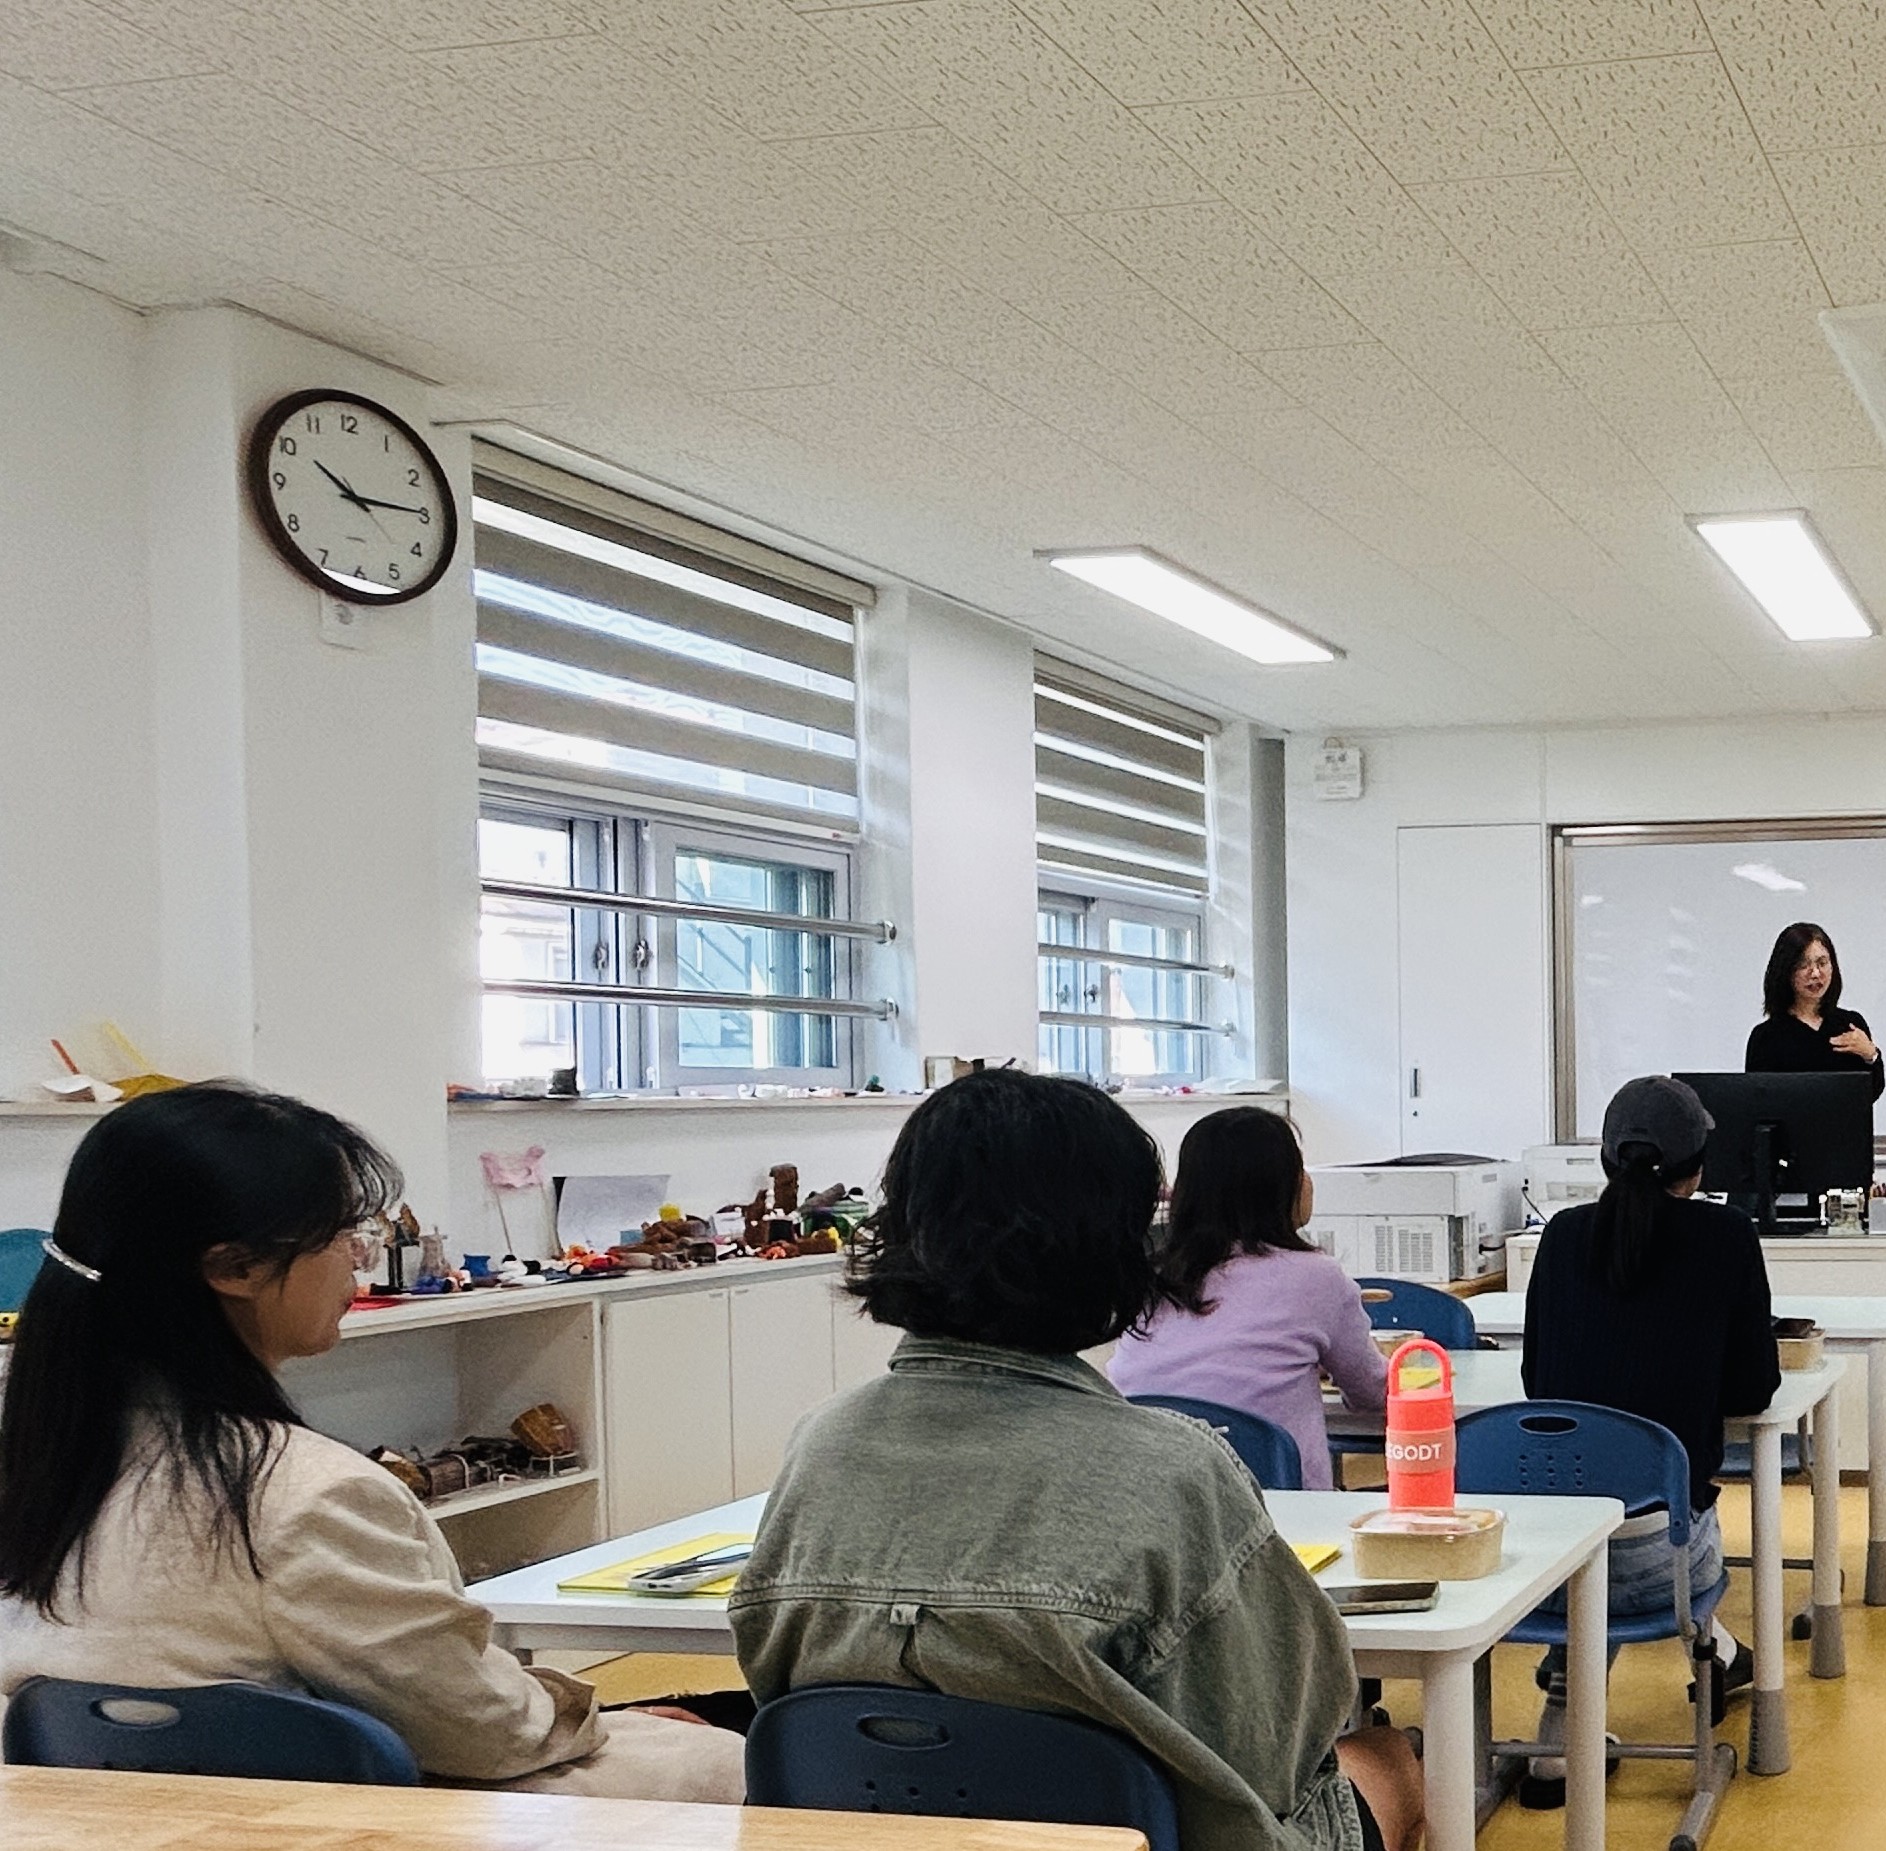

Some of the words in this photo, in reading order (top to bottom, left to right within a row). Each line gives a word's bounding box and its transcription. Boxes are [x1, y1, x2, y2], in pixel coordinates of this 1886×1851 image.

[306, 414, 320, 434] 11
[340, 414, 359, 434] 12
[280, 437, 297, 456] 10
[384, 435, 389, 452] 1
[273, 472, 286, 490] 9
[407, 469, 421, 487] 2
[287, 514, 300, 532] 8
[419, 507, 431, 524] 3
[318, 548, 329, 566] 7
[410, 542, 422, 557] 4
[388, 563, 401, 580] 5
